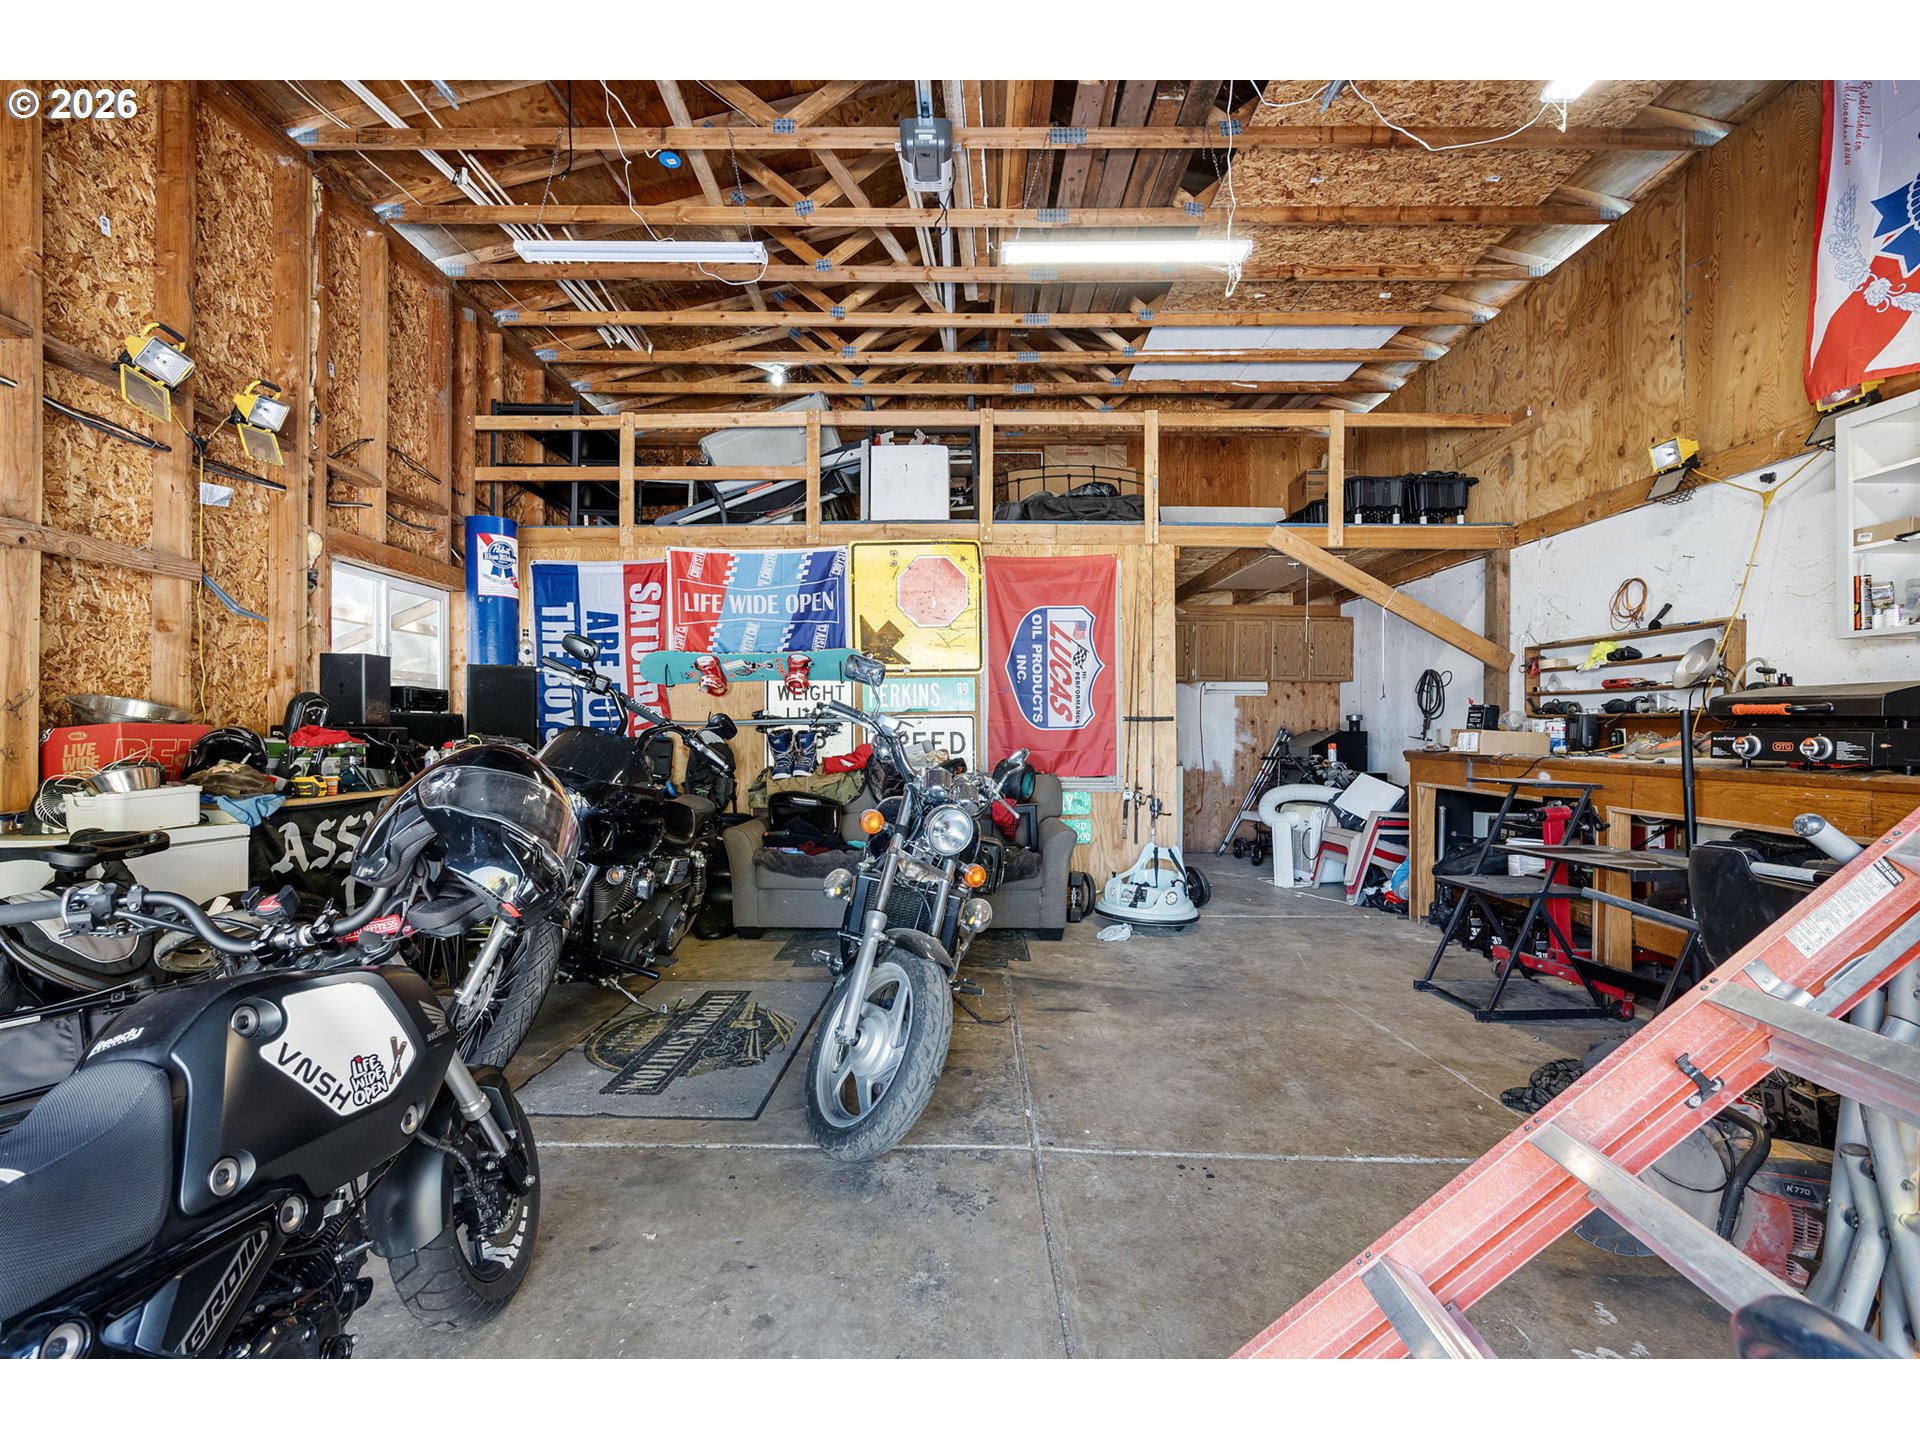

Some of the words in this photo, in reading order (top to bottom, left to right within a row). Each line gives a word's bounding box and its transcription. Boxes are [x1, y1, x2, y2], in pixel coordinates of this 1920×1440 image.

[1856, 81, 1873, 139] Established
[1854, 141, 1865, 152] in
[683, 592, 723, 614] LIFE
[729, 594, 780, 615] WIDE
[785, 590, 834, 614] OPEN
[1031, 613, 1043, 640] OIL
[1016, 654, 1027, 684] INC.
[1049, 620, 1073, 722] LUCAS
[1031, 643, 1043, 723] PRODUCTS
[63, 741, 97, 758] LIVE
[1774, 743, 1792, 751] OTG
[62, 755, 100, 771] WIDE
[278, 1041, 352, 1111] VNSH
[351, 1066, 386, 1091] WIDE
[353, 1077, 388, 1106] OPEN
